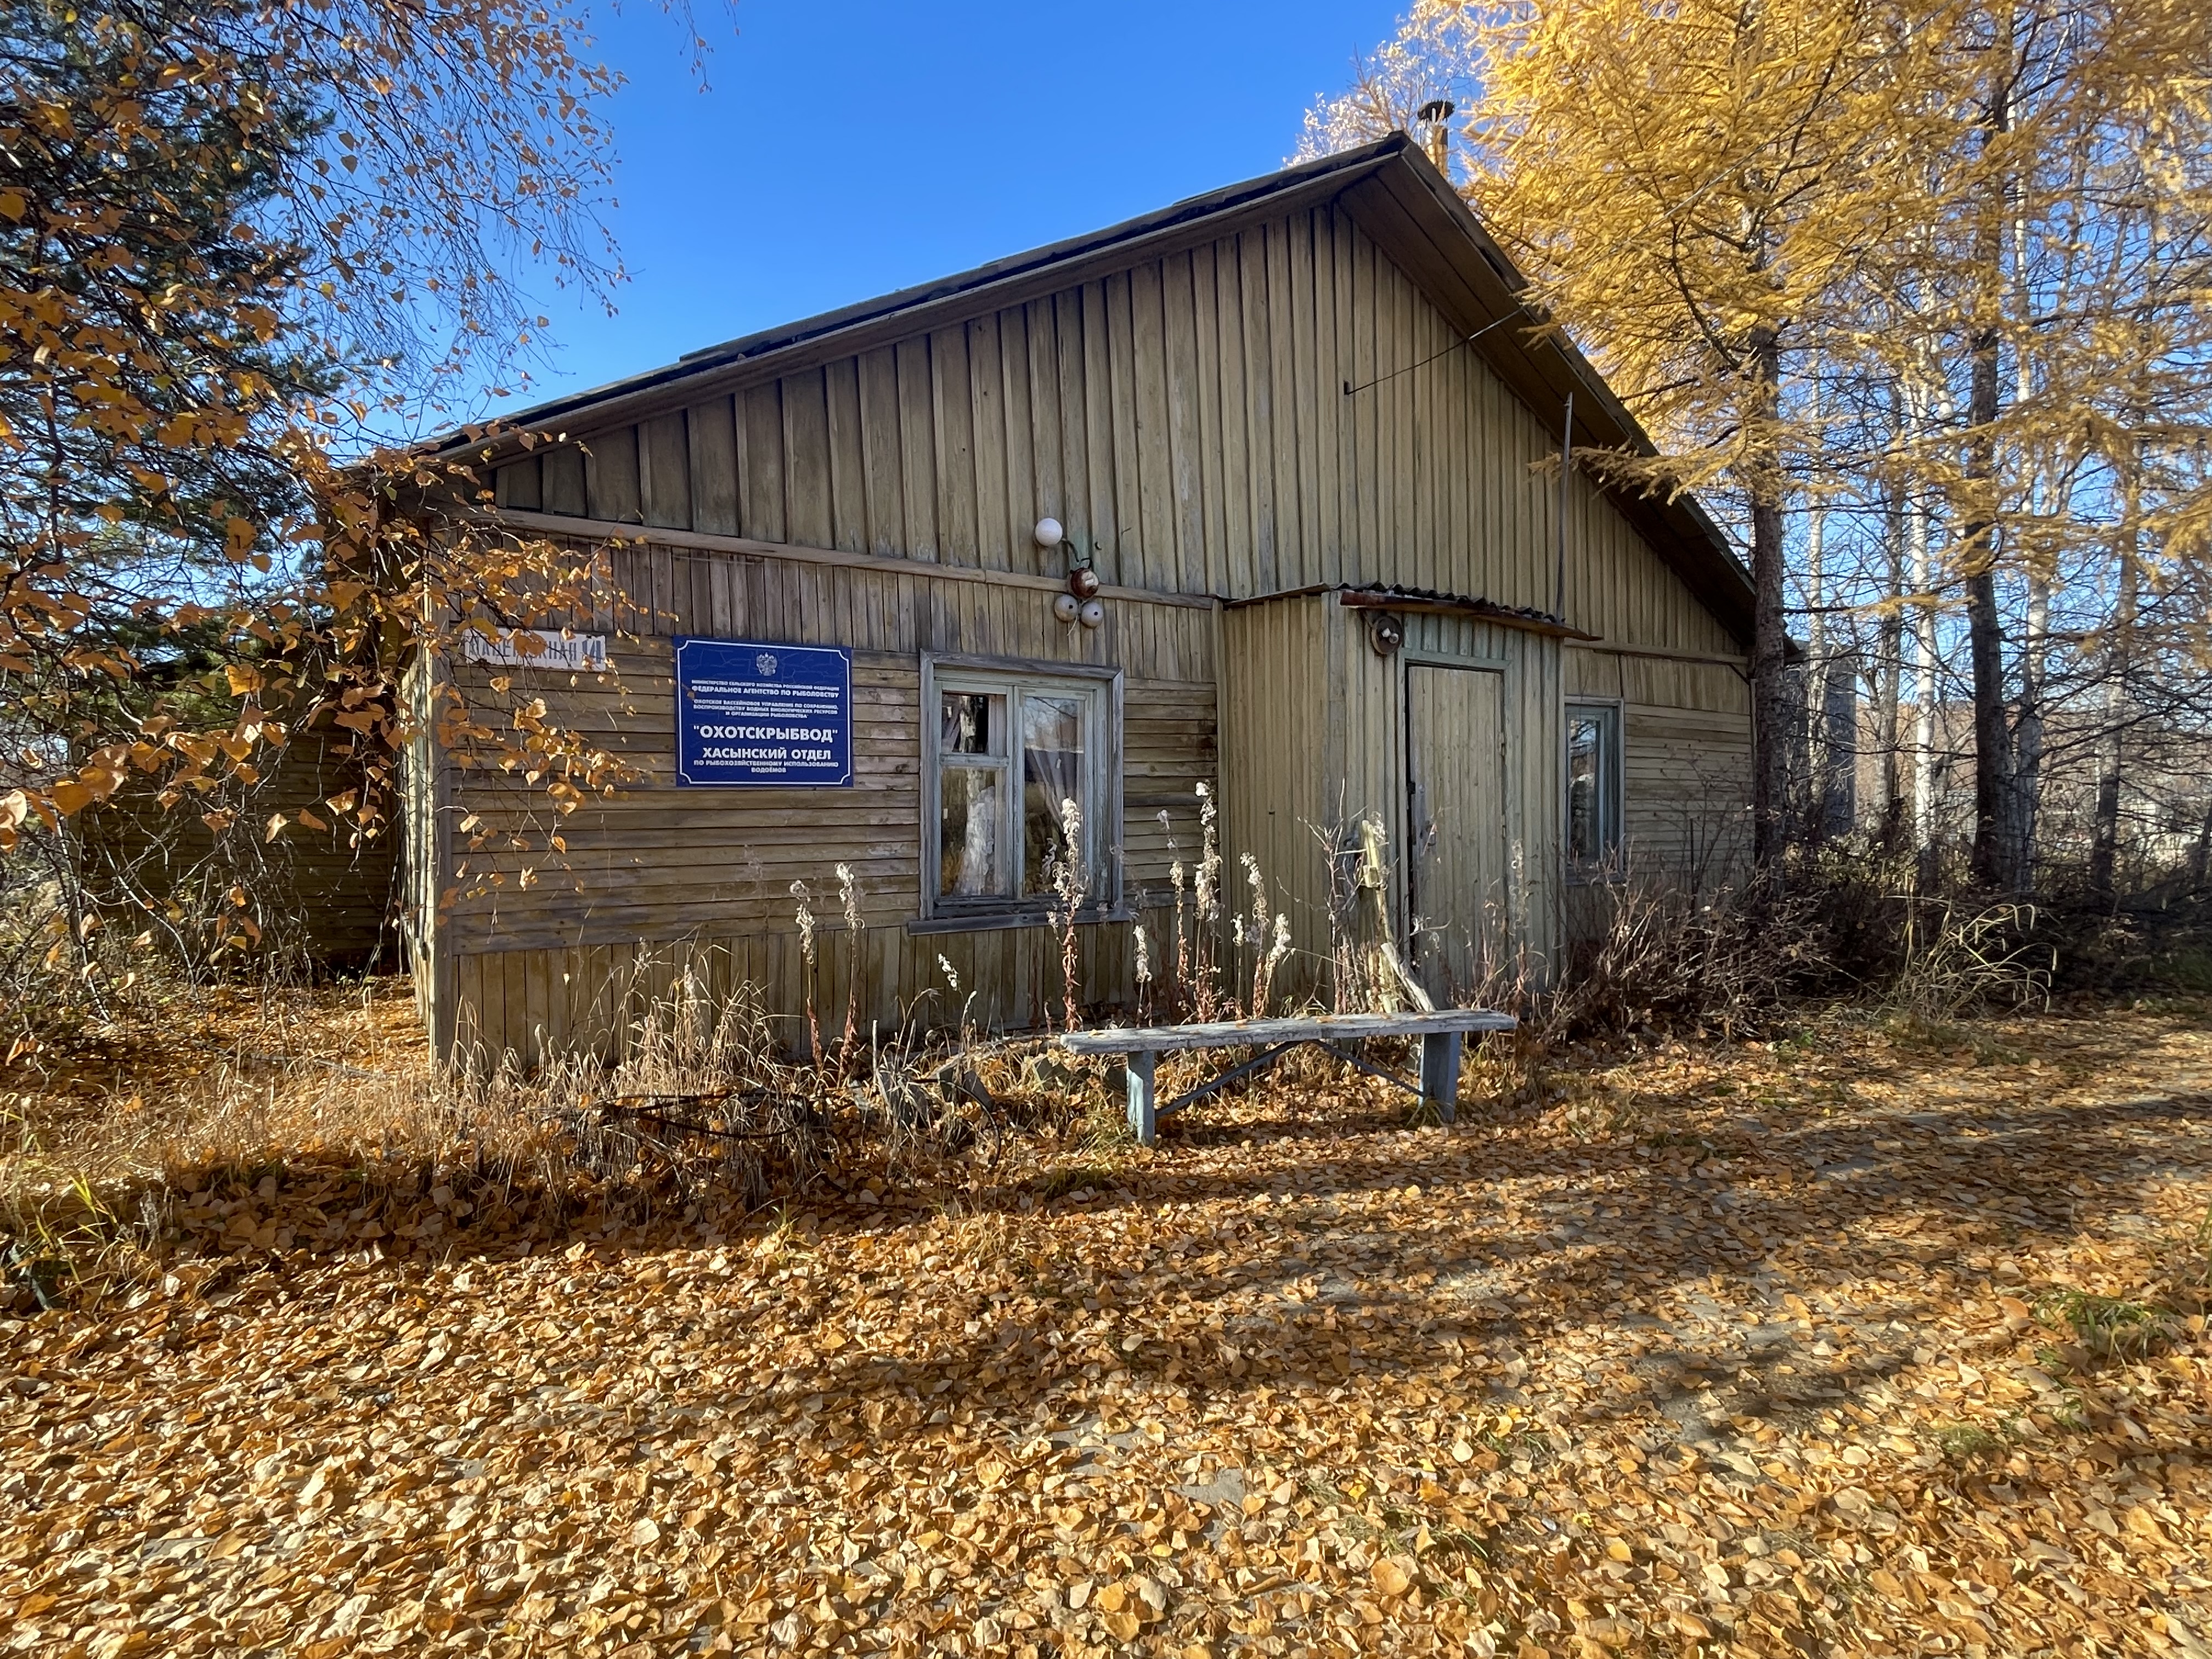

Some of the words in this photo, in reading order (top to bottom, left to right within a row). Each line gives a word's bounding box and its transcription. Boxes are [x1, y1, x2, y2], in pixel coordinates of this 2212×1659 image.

[693, 725, 838, 743] "ОХОТСКРЫБВОД"
[703, 747, 787, 759] ХАСЫНСКИЙ
[791, 749, 831, 761] ОТДЕЛ
